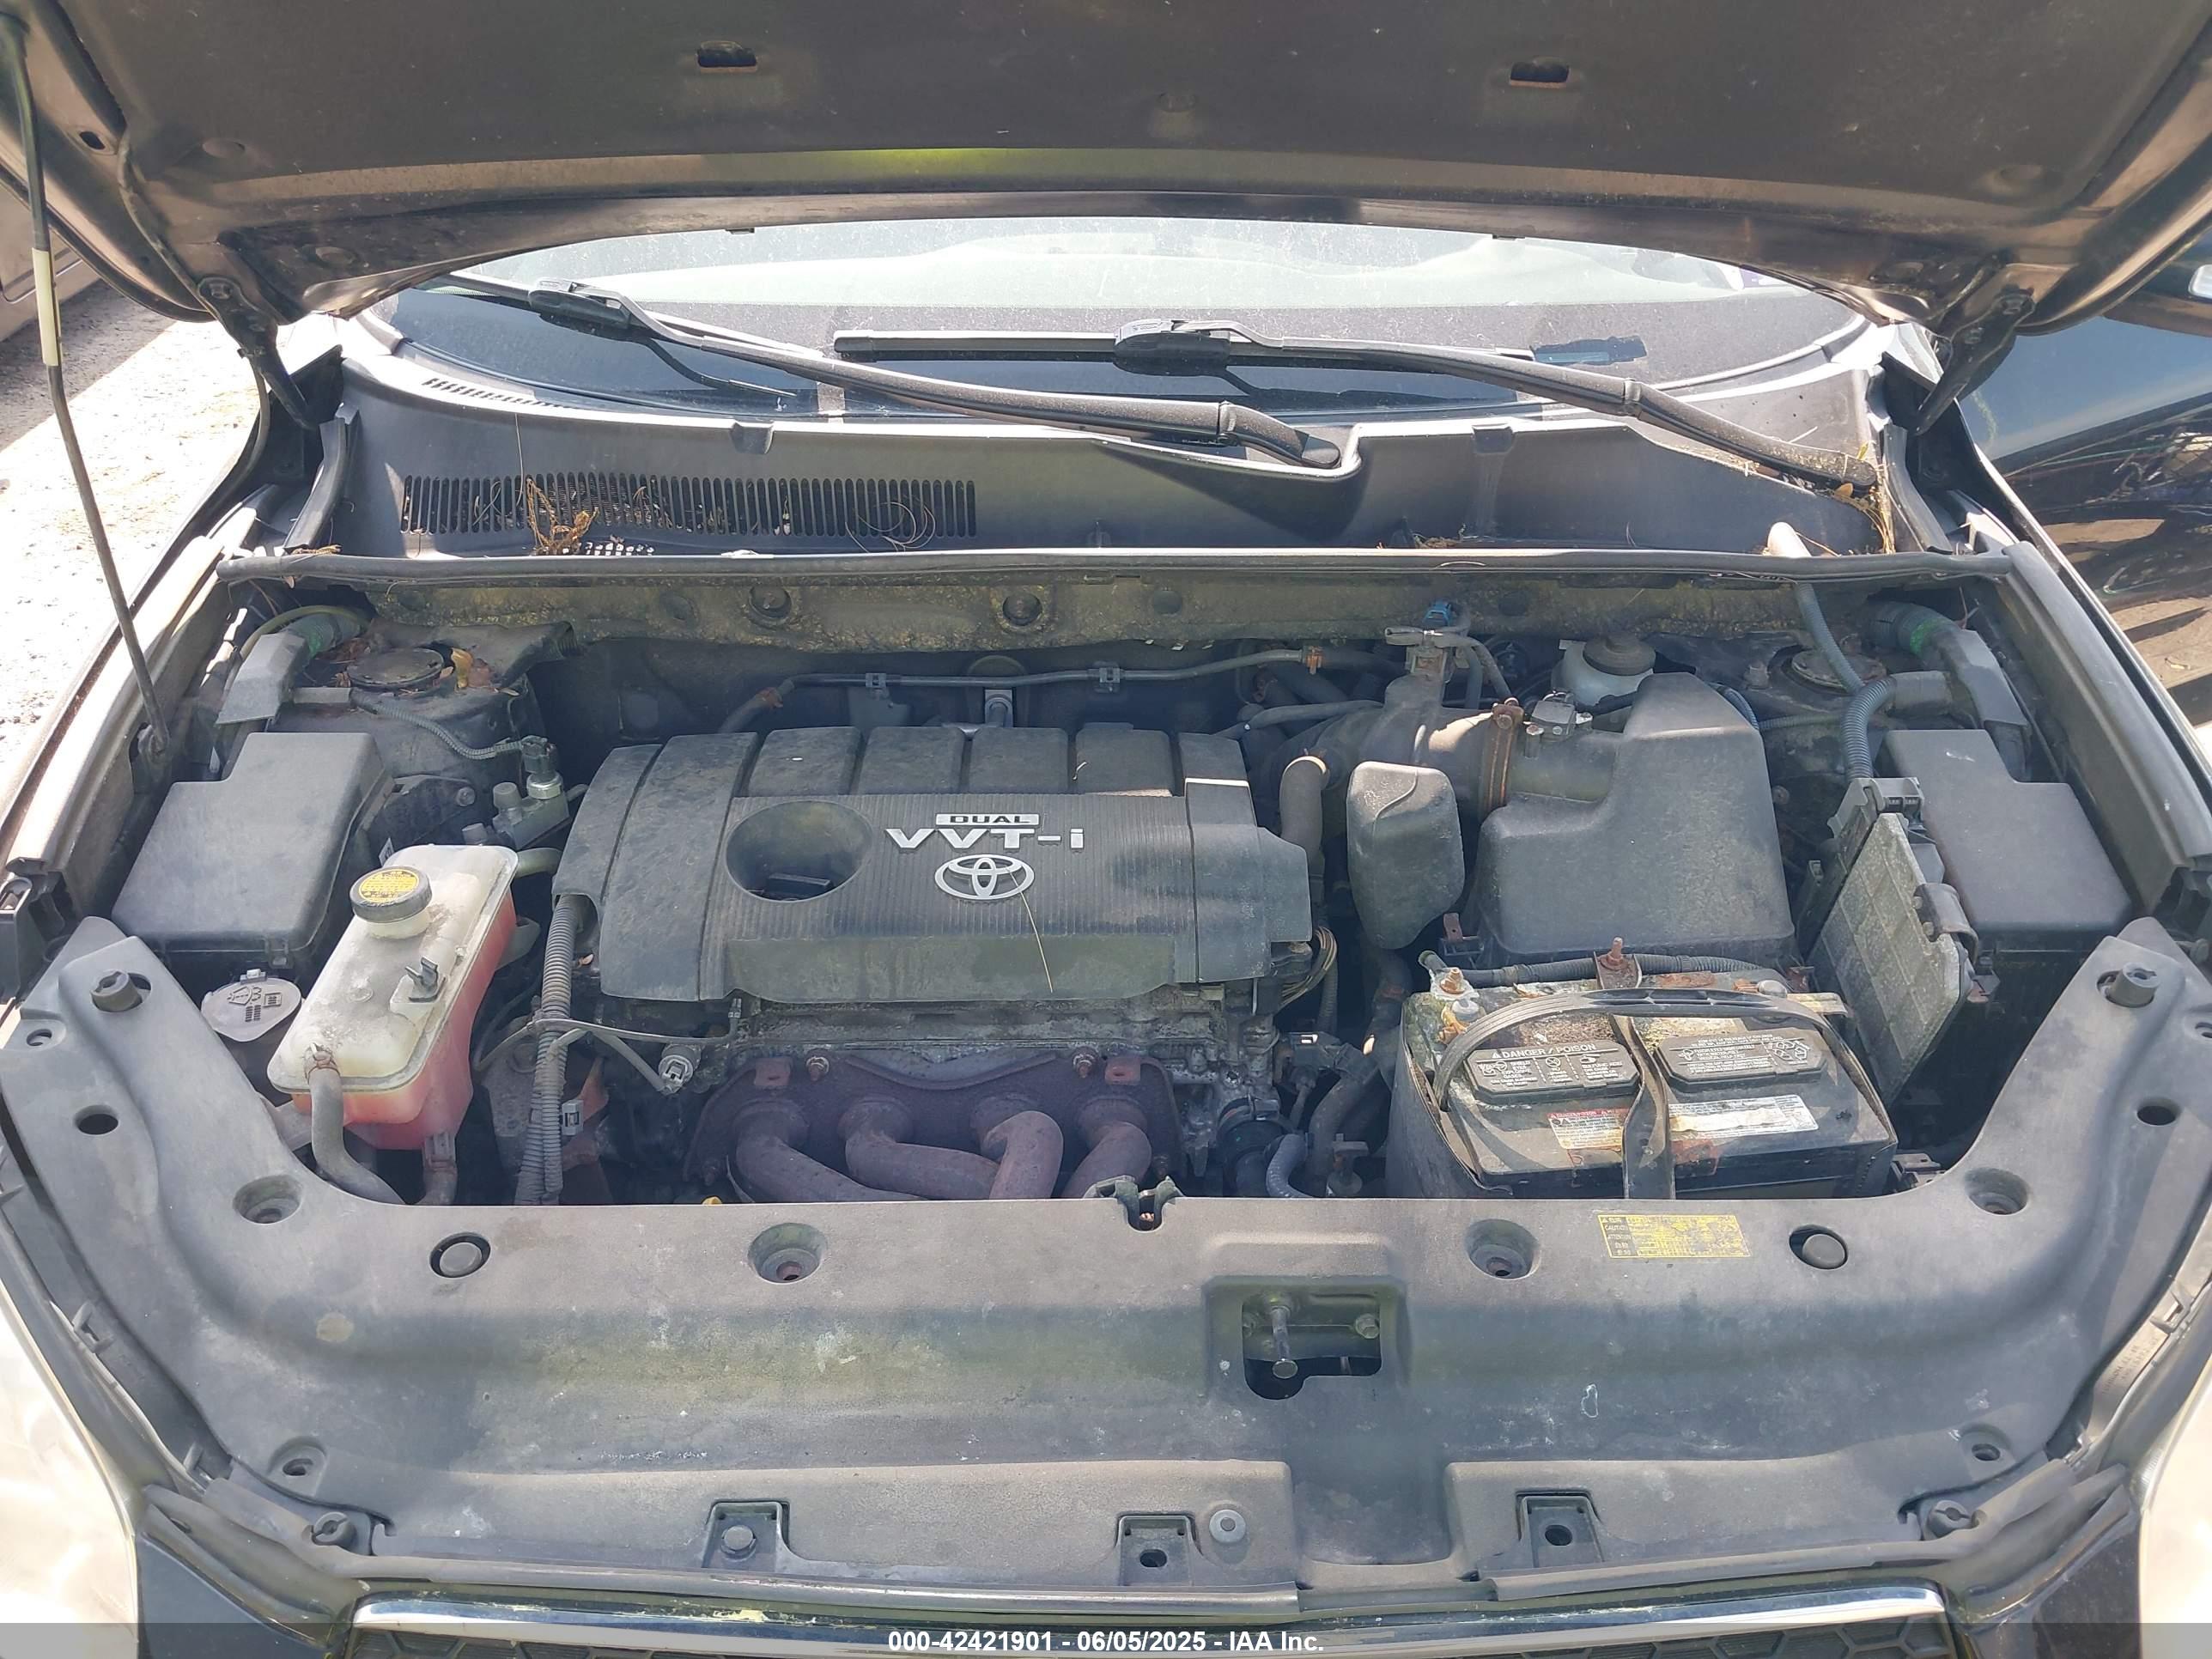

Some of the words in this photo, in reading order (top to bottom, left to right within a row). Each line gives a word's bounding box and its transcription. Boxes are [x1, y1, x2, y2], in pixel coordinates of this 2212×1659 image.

[950, 815, 1031, 823] DUAL
[884, 828, 1084, 849] VVT-i
[1502, 1048, 1546, 1059] DANGER
[1556, 1043, 1597, 1054] POISON
